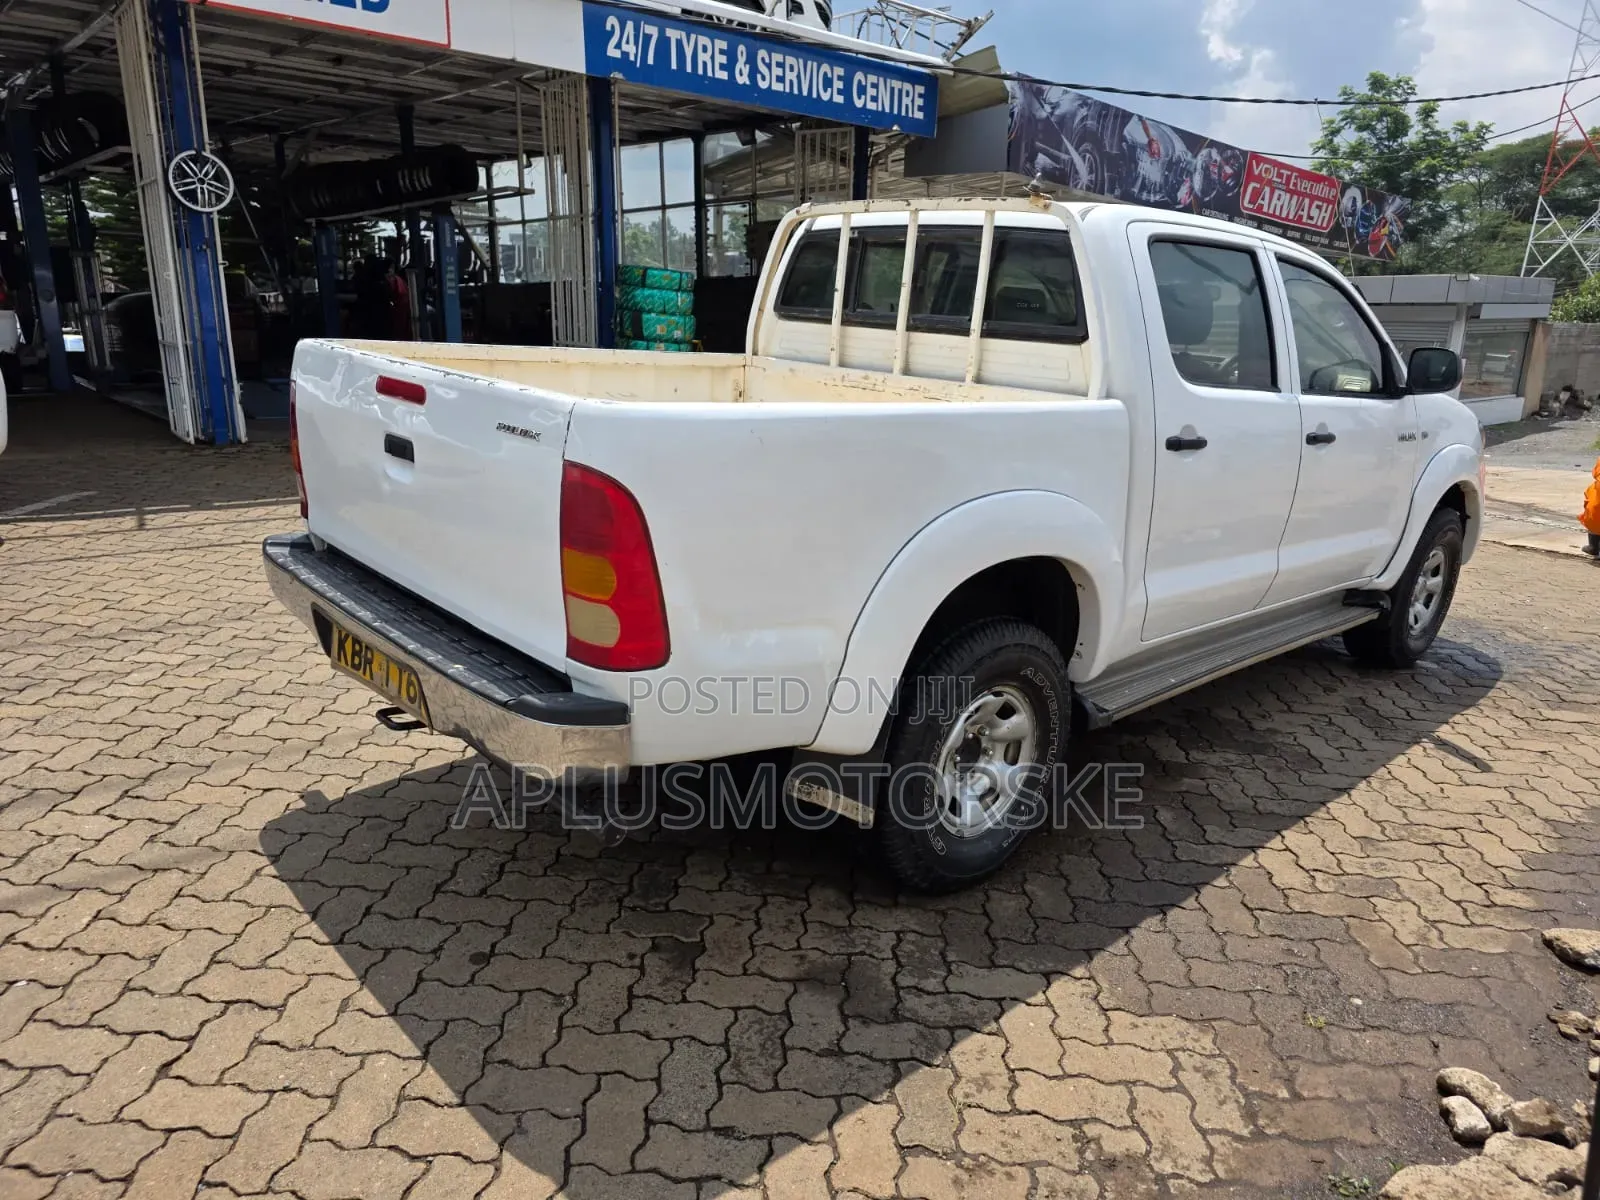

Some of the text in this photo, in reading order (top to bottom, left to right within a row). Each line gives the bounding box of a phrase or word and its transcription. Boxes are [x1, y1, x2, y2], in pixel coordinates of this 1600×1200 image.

[605, 15, 925, 120] 24/7 TYRE & SERVICE CENTRE
[1252, 160, 1292, 185] VOLT
[1243, 181, 1333, 228] CARWASH
[336, 629, 374, 681] KBR
